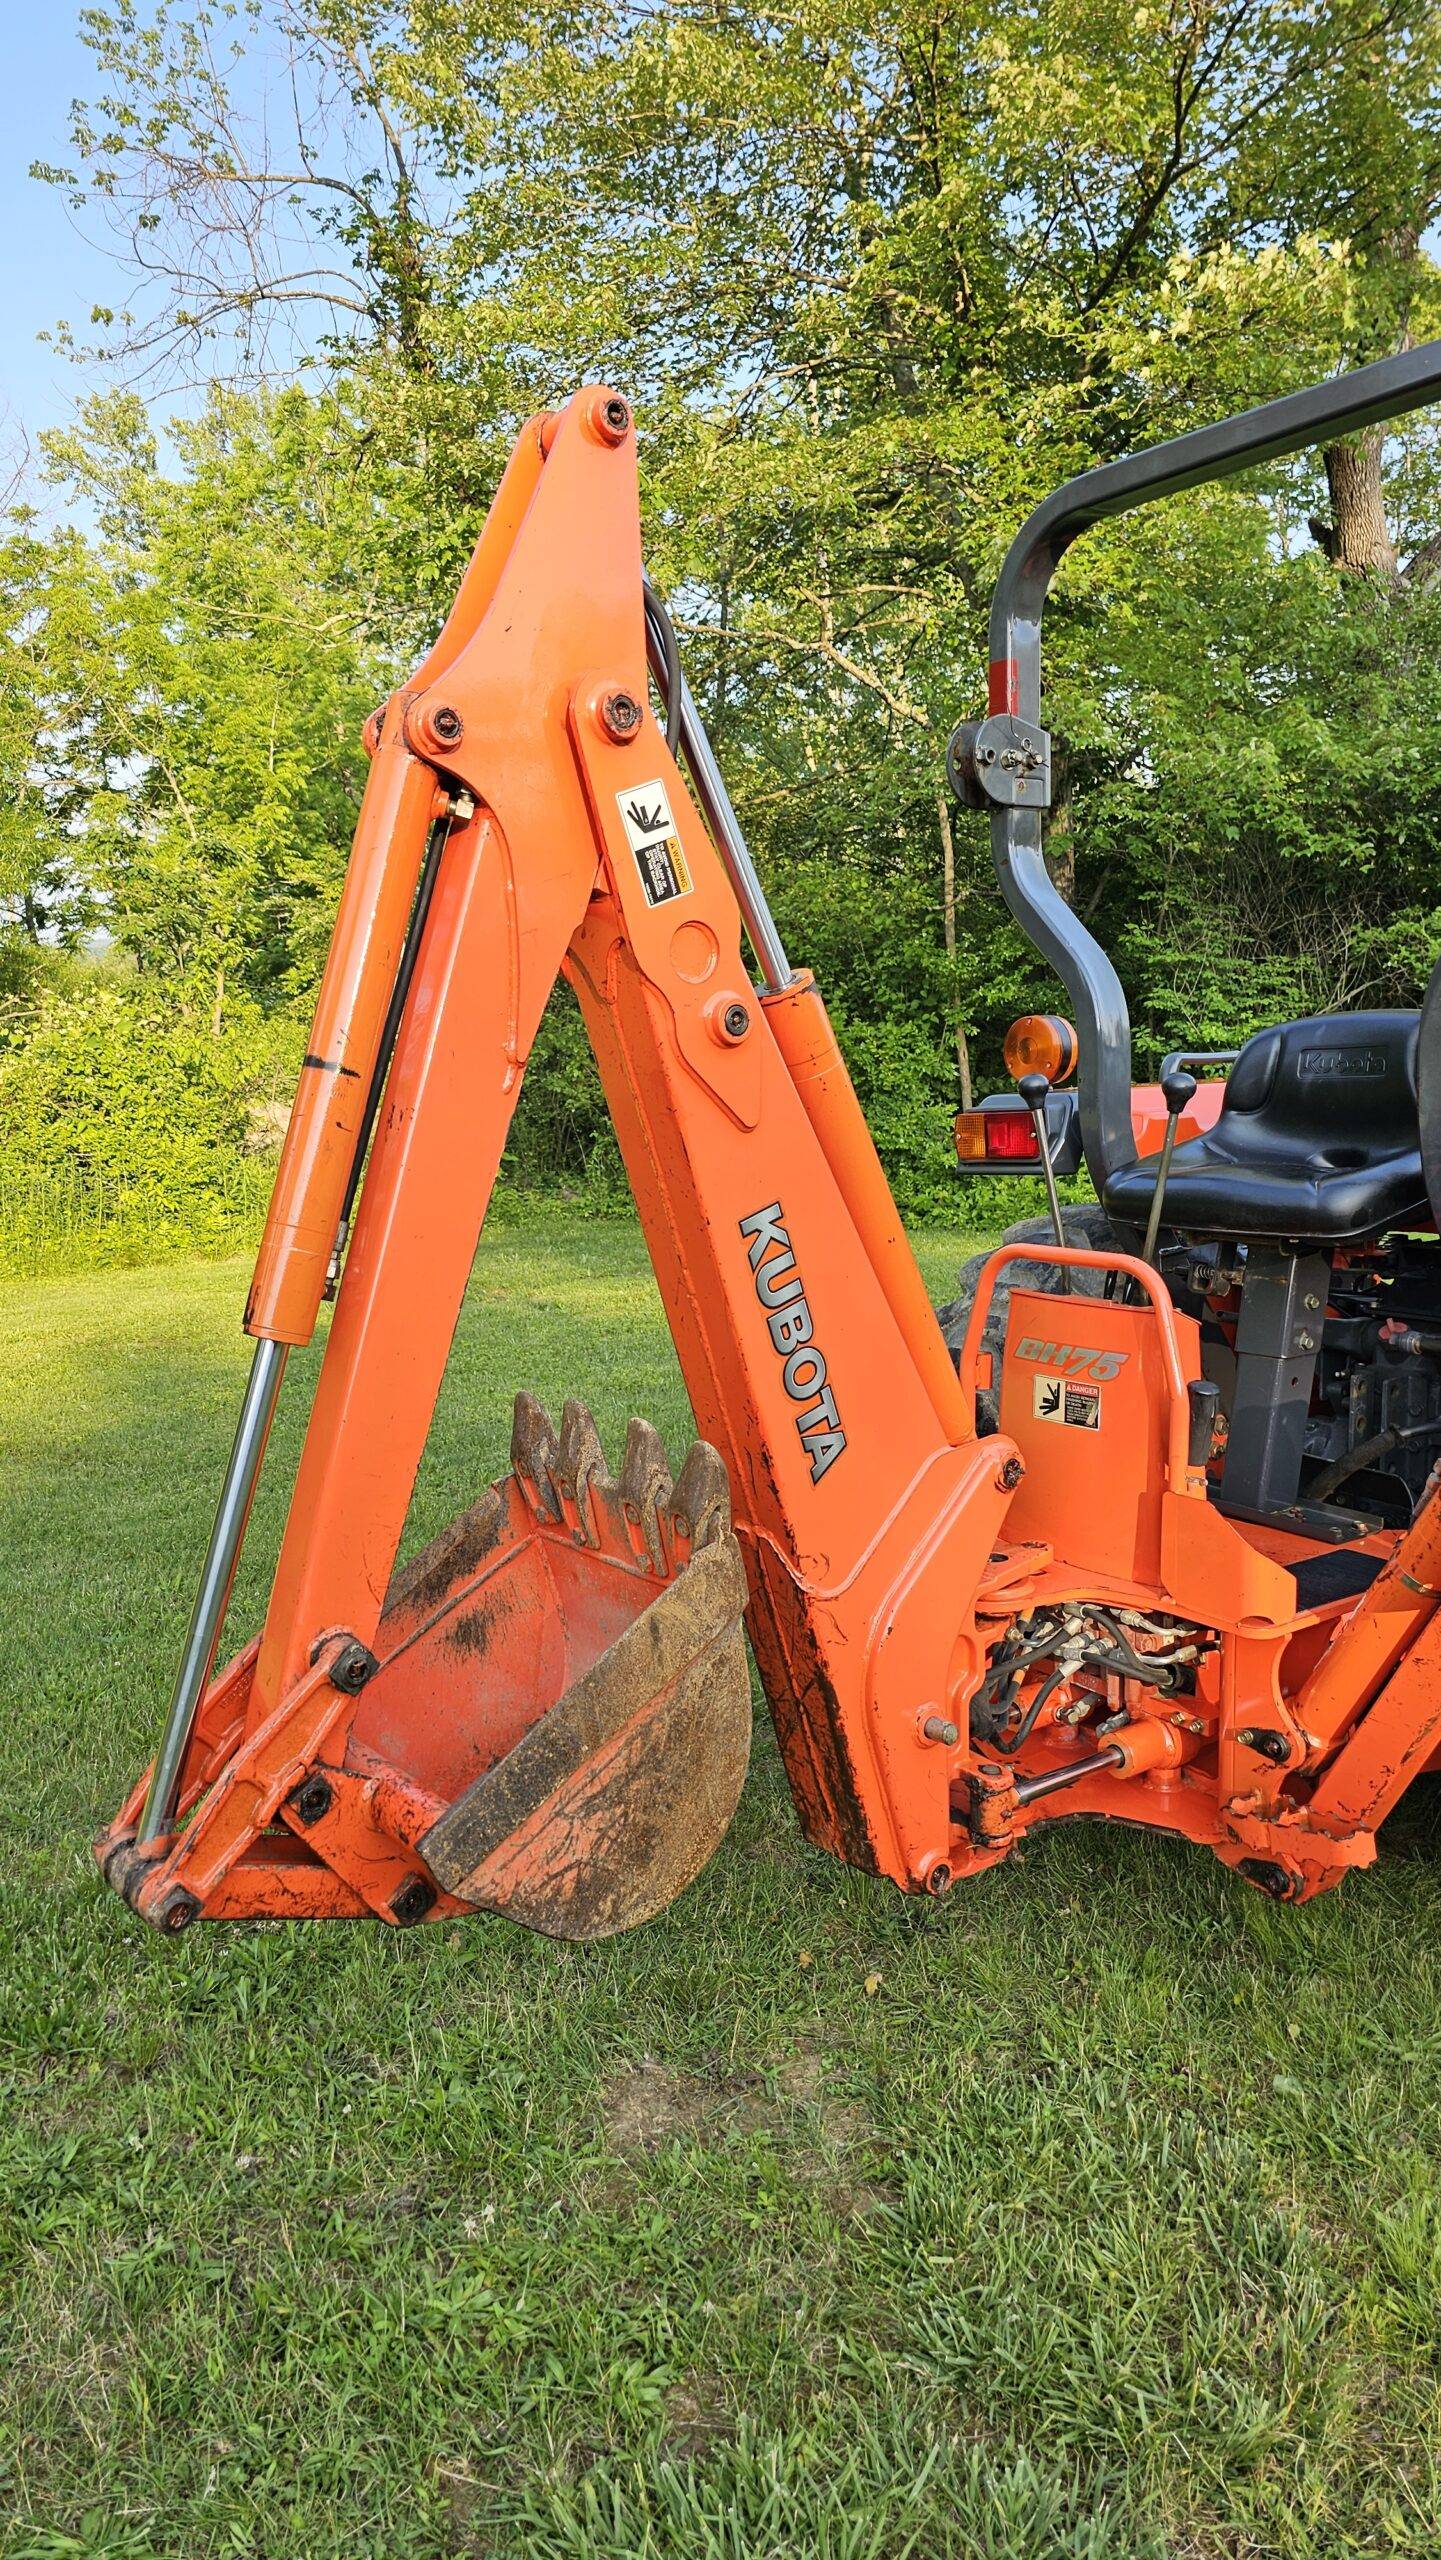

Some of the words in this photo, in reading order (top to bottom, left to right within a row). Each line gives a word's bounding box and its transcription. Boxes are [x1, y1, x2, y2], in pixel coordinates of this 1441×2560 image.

[672, 850, 687, 887] WARNING
[1306, 1051, 1386, 1073] Kubota
[739, 1201, 847, 1486] KUBOTA
[1014, 1337, 1130, 1381] BH75
[1072, 1384, 1097, 1395] DANGER
